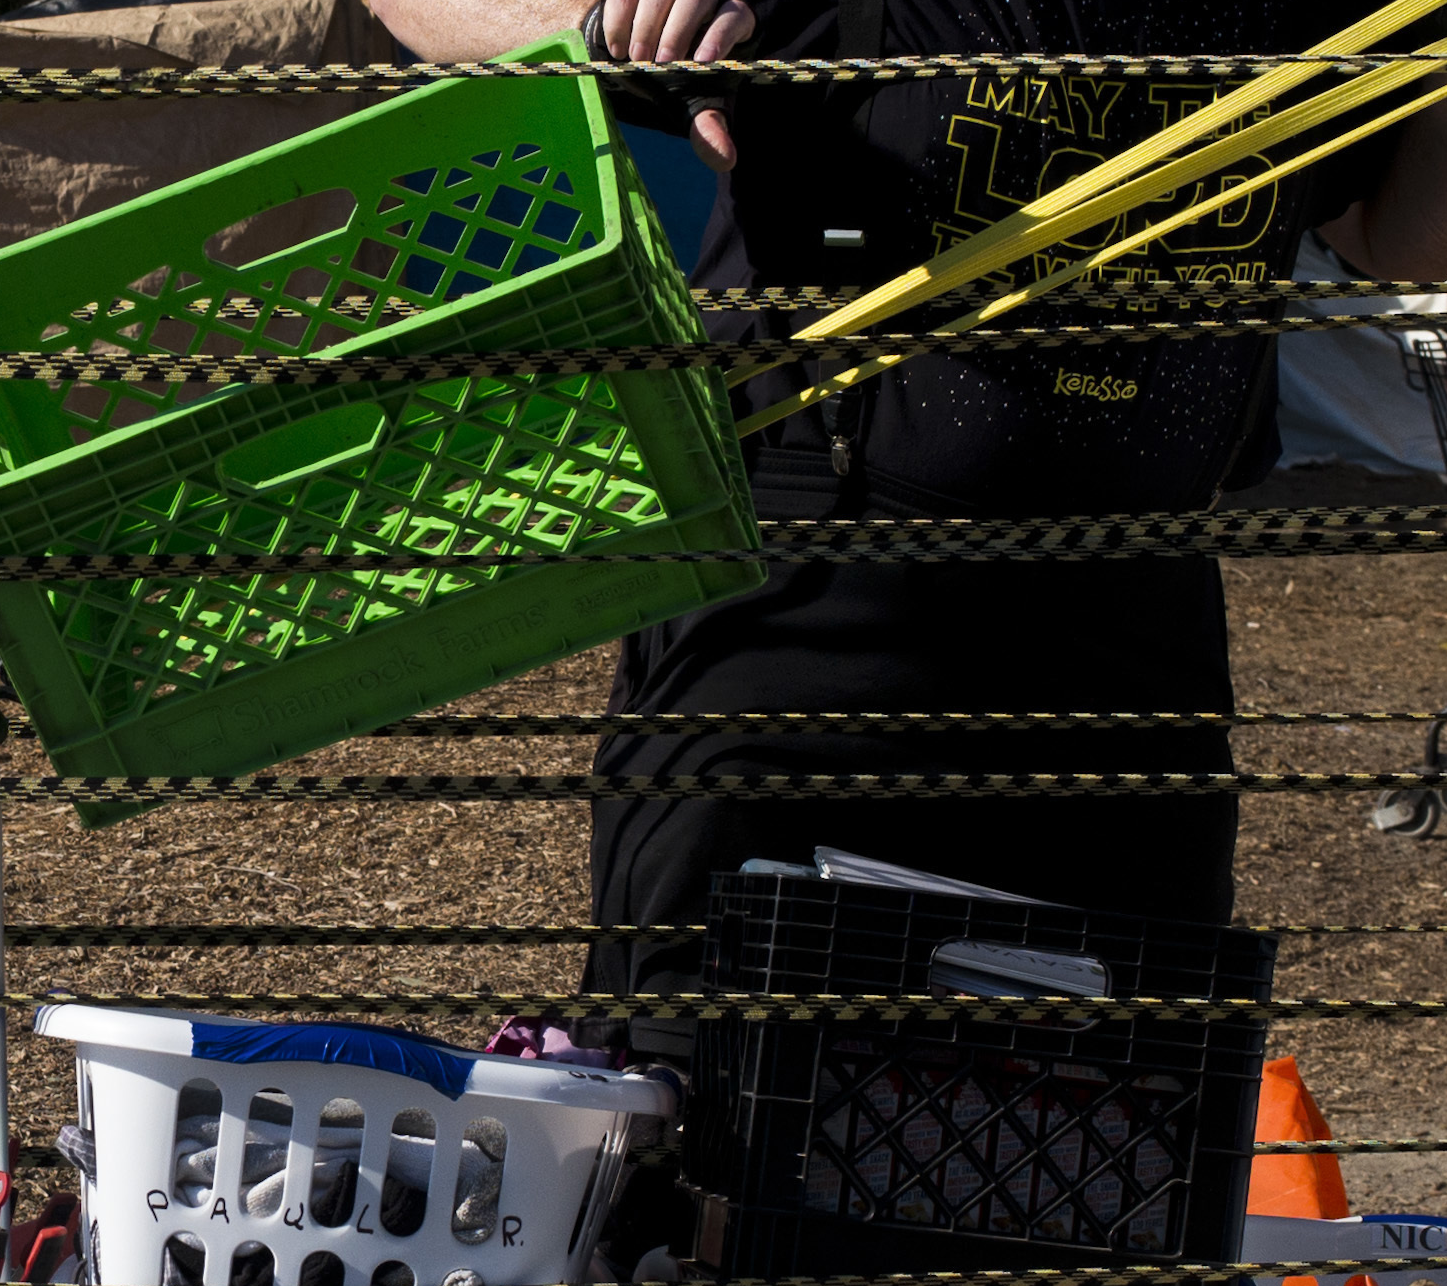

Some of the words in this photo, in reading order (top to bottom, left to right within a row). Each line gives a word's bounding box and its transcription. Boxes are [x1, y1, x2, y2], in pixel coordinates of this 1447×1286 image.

[967, 74, 1127, 140] MAY
[1148, 78, 1272, 141] TE
[229, 646, 427, 735] Shamrock
[146, 1189, 374, 1235] PAUL
